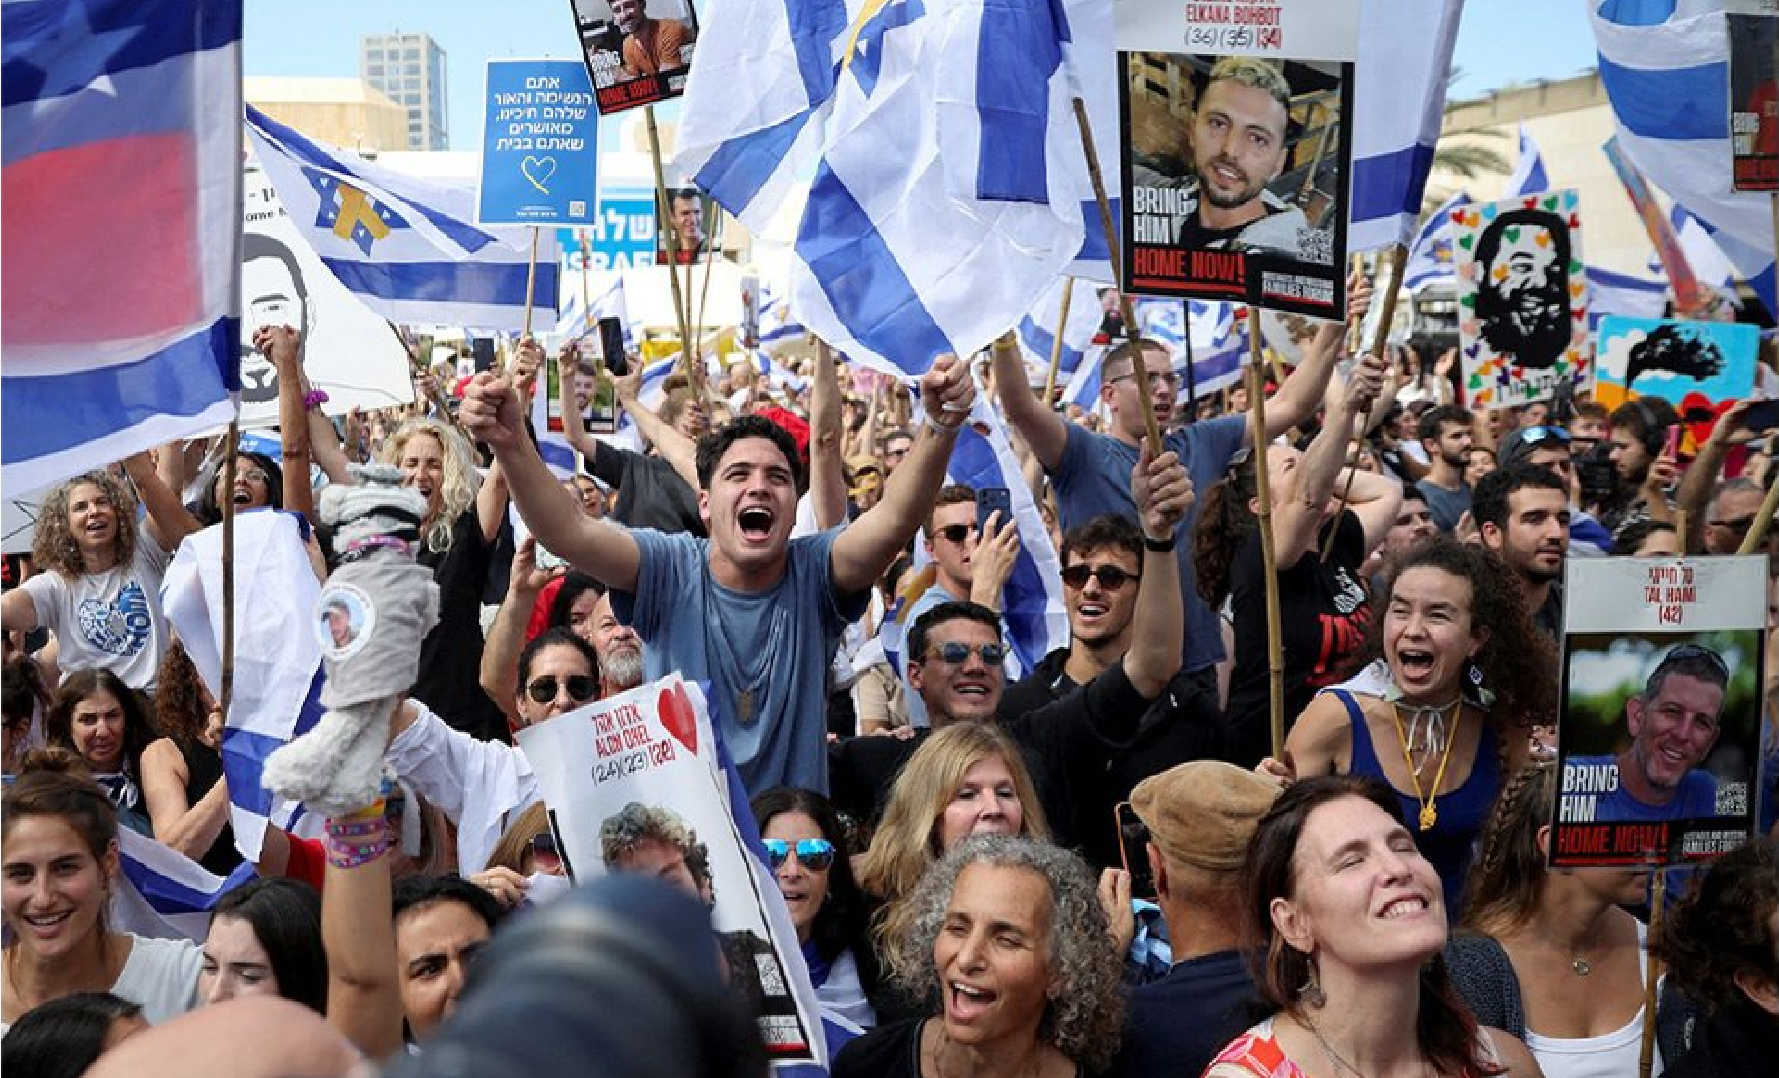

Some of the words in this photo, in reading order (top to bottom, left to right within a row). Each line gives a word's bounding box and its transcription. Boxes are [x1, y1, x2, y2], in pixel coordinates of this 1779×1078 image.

[1186, 4, 1230, 23] ELKANA
[1233, 6, 1282, 25] BOHBOT
[1184, 28, 1218, 47] (36)
[526, 76, 560, 89] אתם
[543, 106, 586, 120] שלהם
[509, 122, 574, 135] מאושרים
[496, 138, 533, 151] בבית
[535, 138, 584, 150] שאתם
[1133, 187, 1190, 214] BRING
[1133, 214, 1170, 243] HIM
[1133, 248, 1187, 277] HOME
[1191, 250, 1246, 283] NOW!
[1659, 604, 1683, 624] (42)
[1563, 764, 1618, 792] BRING
[1560, 795, 1597, 822] HIM
[1558, 825, 1610, 853] HOME
[1615, 823, 1668, 853] NOW!
